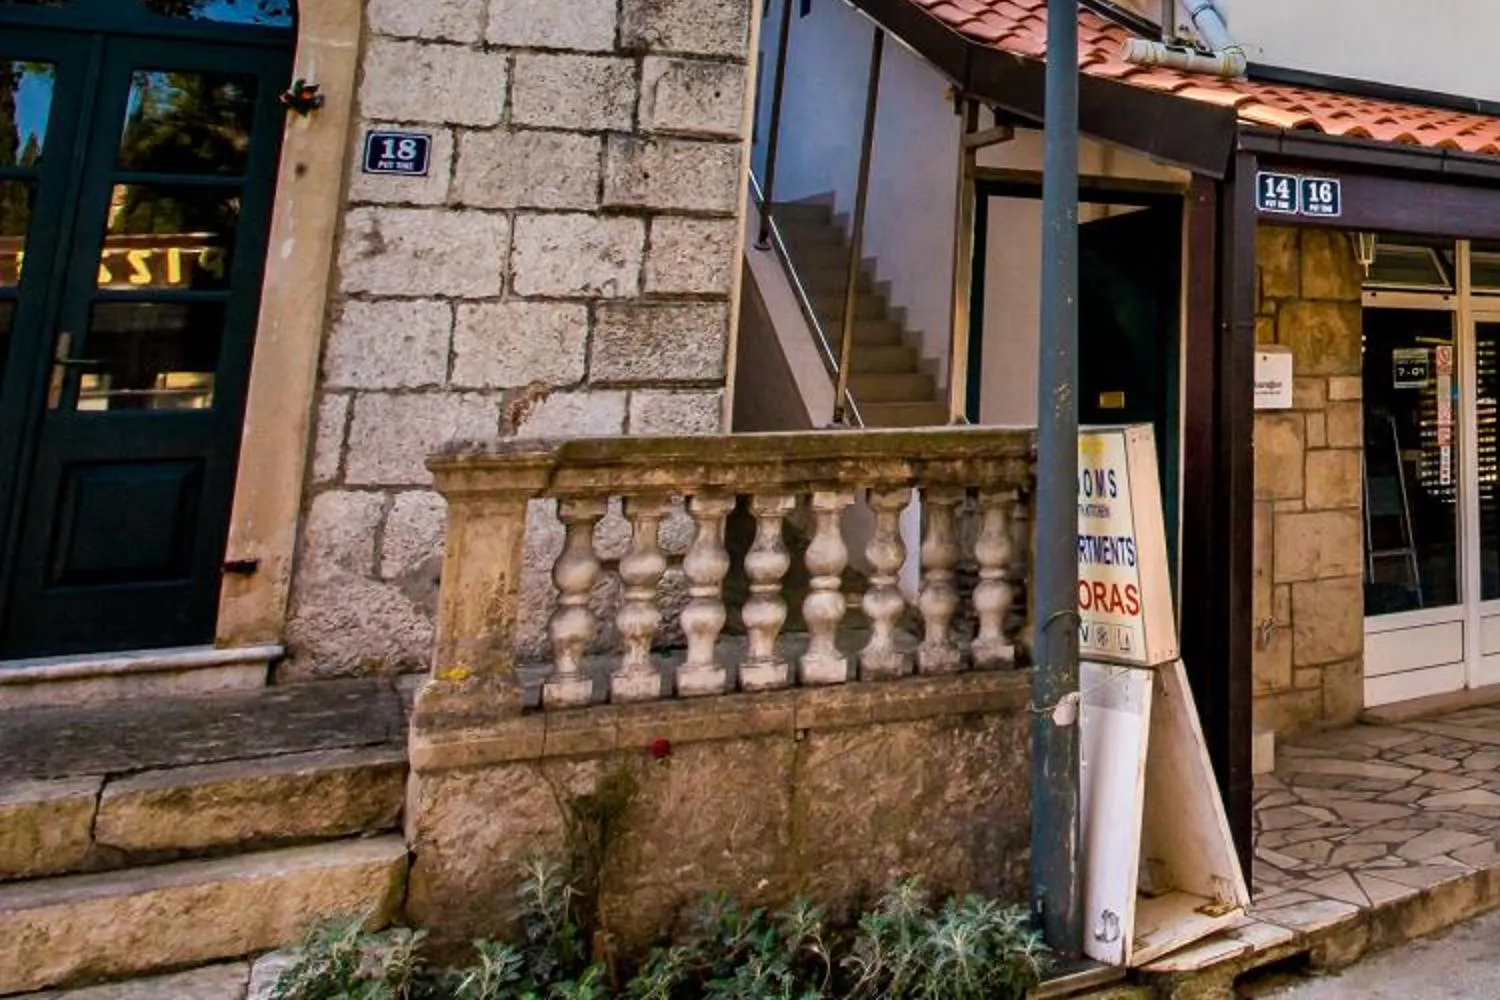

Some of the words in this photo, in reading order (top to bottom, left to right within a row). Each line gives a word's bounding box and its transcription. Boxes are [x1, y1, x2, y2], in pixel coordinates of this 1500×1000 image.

[380, 137, 417, 160] 18
[1265, 177, 1290, 199] 14
[1309, 182, 1332, 203] 16
[1078, 467, 1117, 499] OMS
[1078, 535, 1135, 568] RTMENTS
